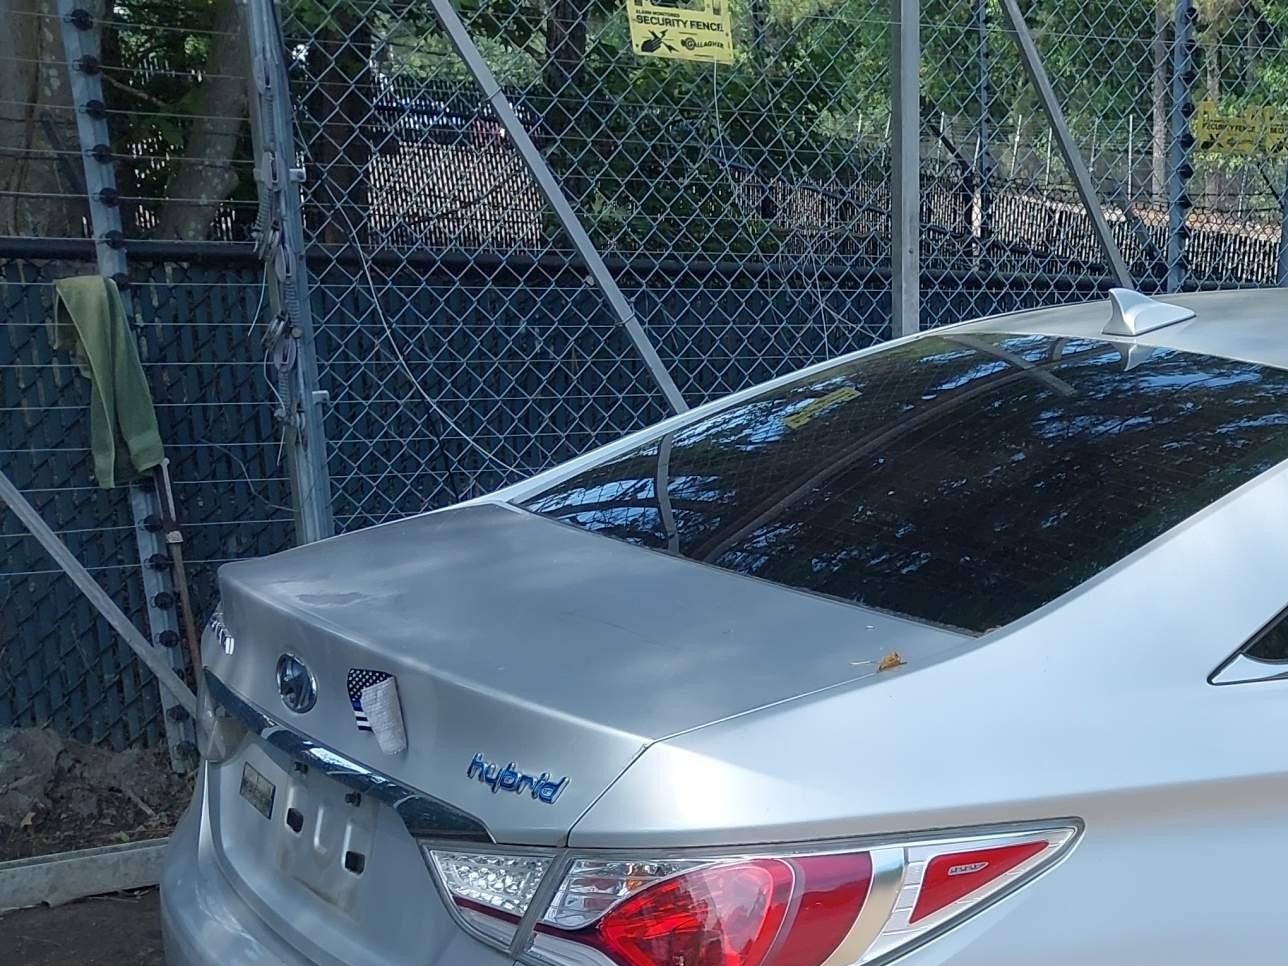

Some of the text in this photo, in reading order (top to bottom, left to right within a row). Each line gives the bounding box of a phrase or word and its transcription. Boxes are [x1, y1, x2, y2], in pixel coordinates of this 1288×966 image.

[635, 14, 724, 32] SECURITY FENCE
[466, 751, 571, 805] hybrid
